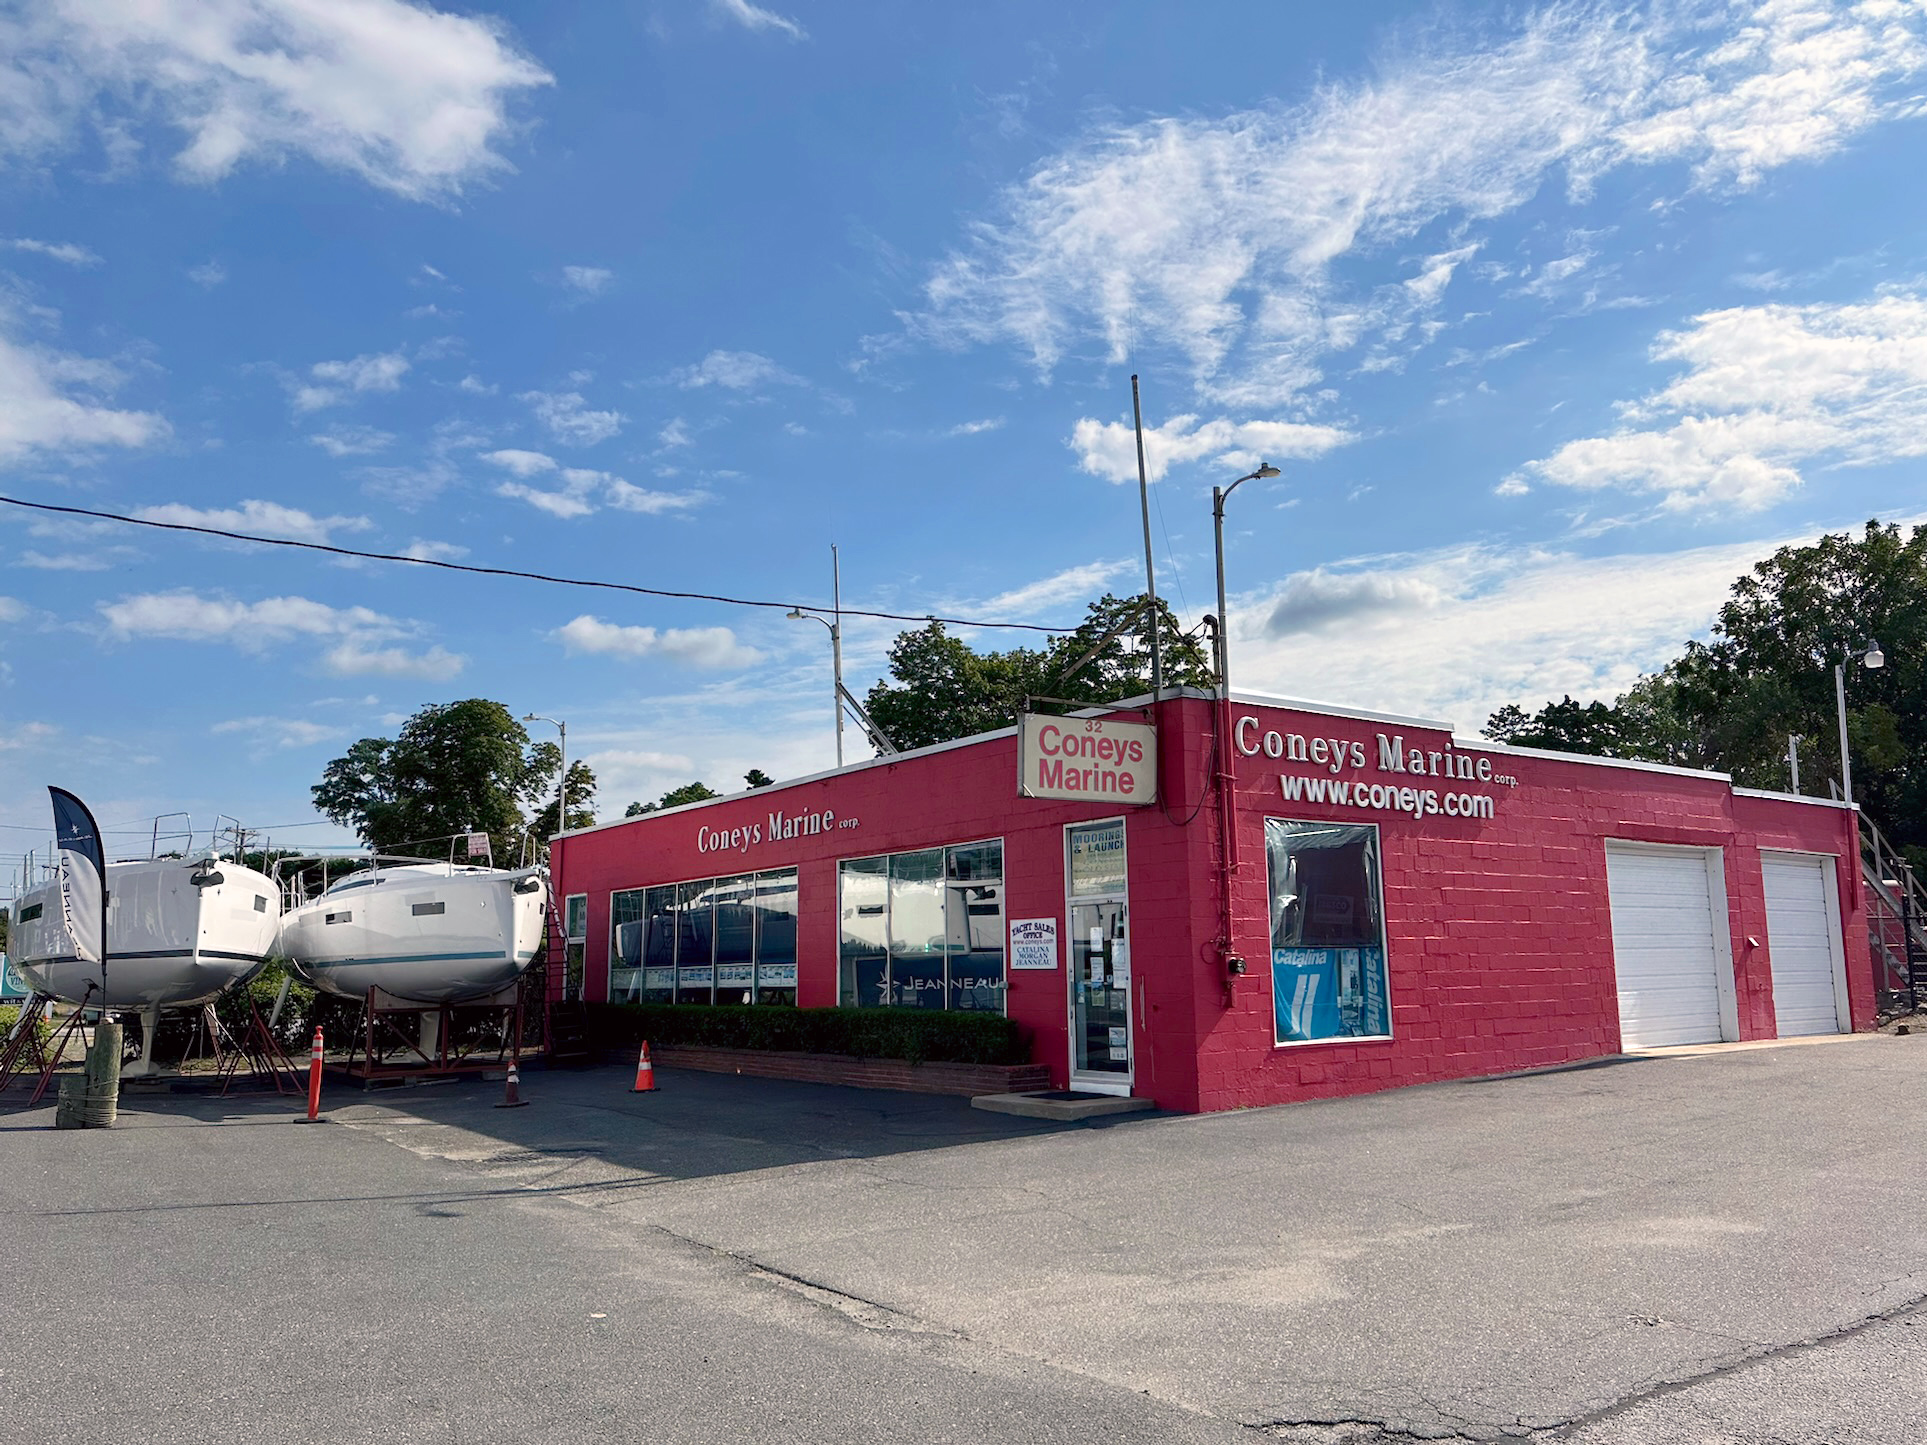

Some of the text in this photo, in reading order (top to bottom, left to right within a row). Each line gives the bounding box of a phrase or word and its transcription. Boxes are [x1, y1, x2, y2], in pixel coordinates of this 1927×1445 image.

[1085, 720, 1103, 733] 32
[1039, 724, 1143, 767] Coneys
[1234, 716, 1520, 789] Coneys Marine corp.
[1039, 758, 1135, 794] Marine
[1280, 774, 1495, 820] www.coneys.com
[697, 807, 861, 854] Coneys Marine corp.
[1074, 845, 1082, 854] &
[1012, 923, 1055, 936] YACHT SALES
[1274, 948, 1327, 965] Catalina
[904, 975, 999, 990] JEANNEAU
